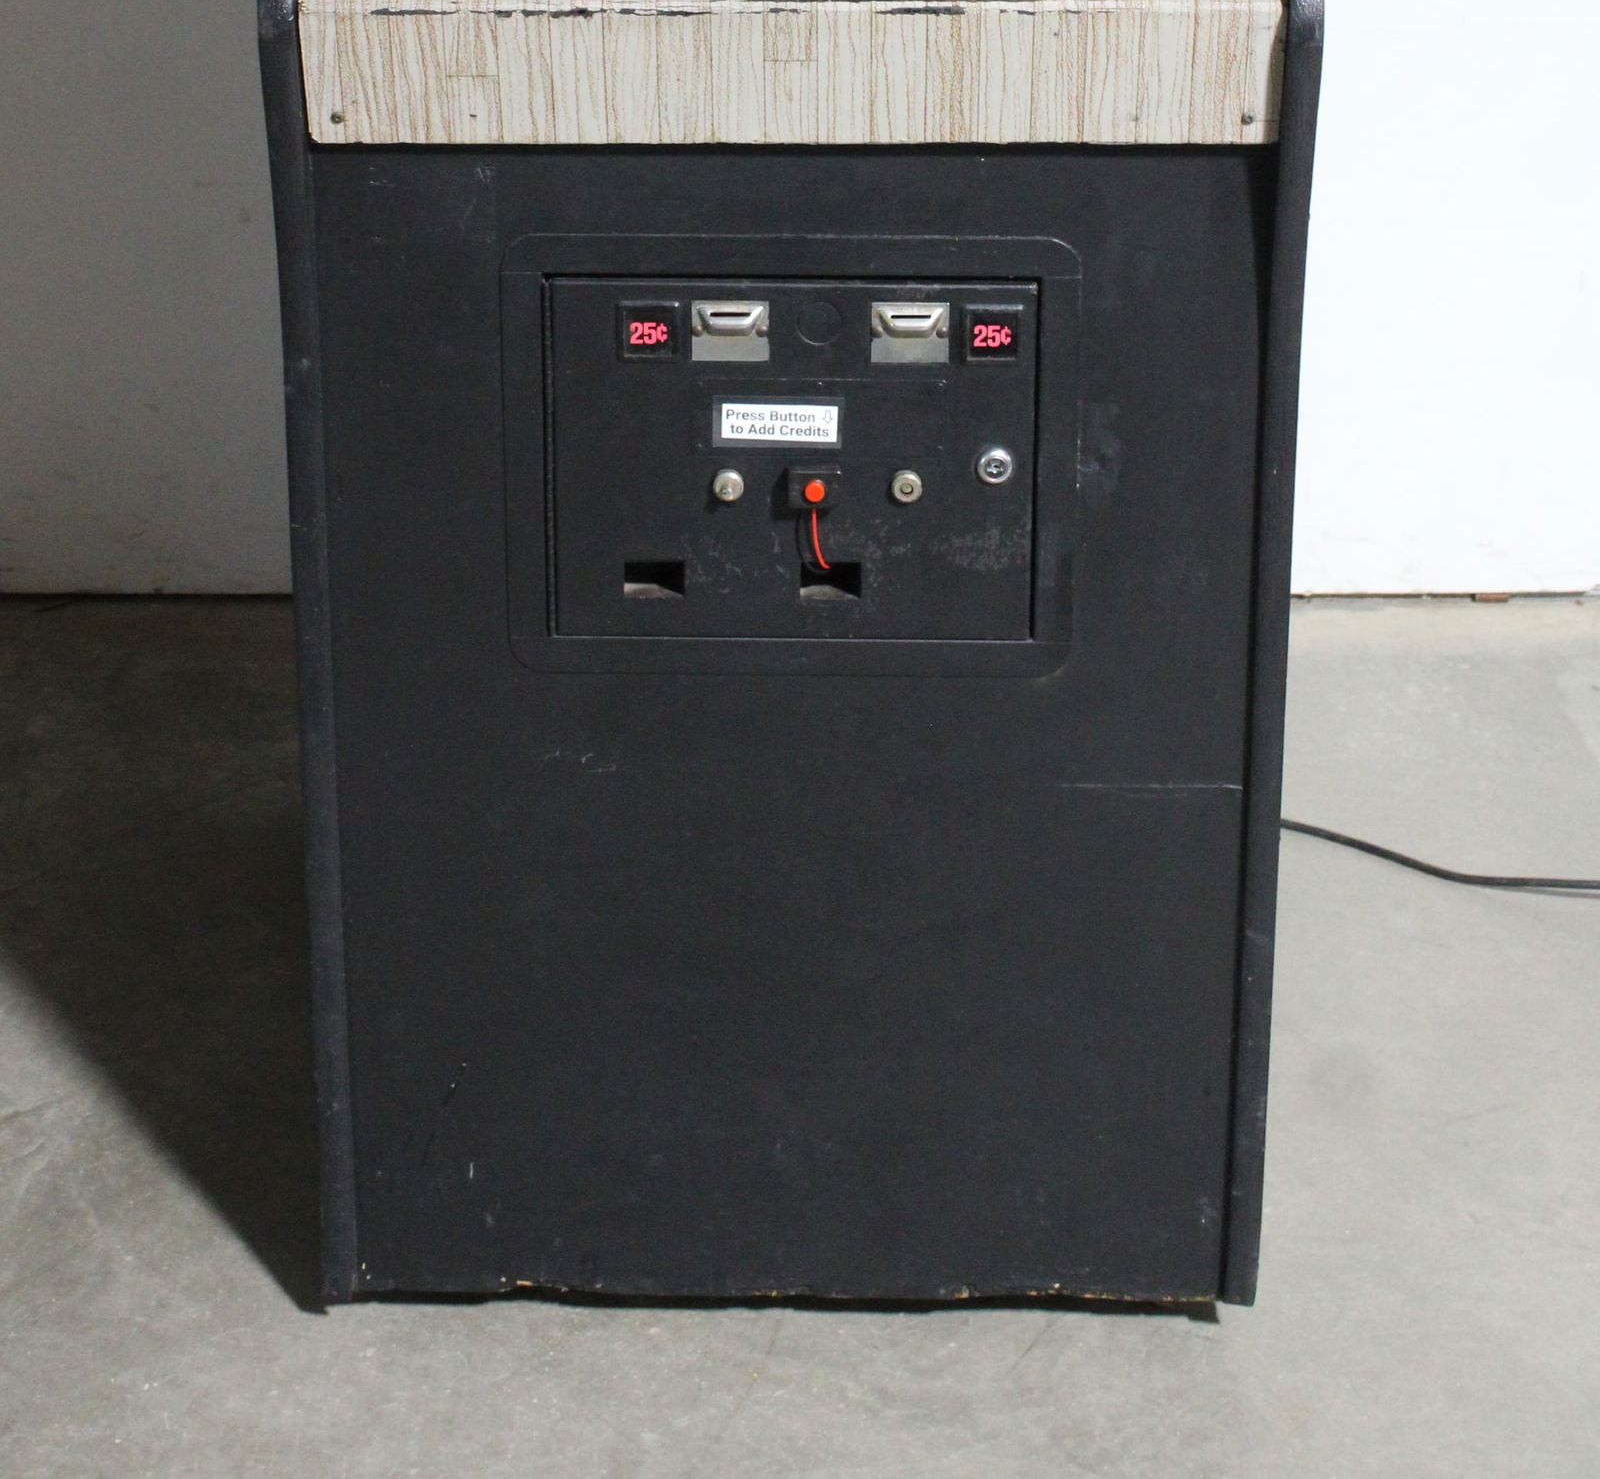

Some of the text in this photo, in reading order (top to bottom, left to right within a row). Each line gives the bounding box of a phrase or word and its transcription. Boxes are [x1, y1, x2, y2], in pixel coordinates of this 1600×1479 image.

[629, 321, 668, 345] 25¢
[973, 324, 1012, 348] 25¢
[725, 408, 816, 423] Press Button
[730, 424, 830, 437] to Add Credits
